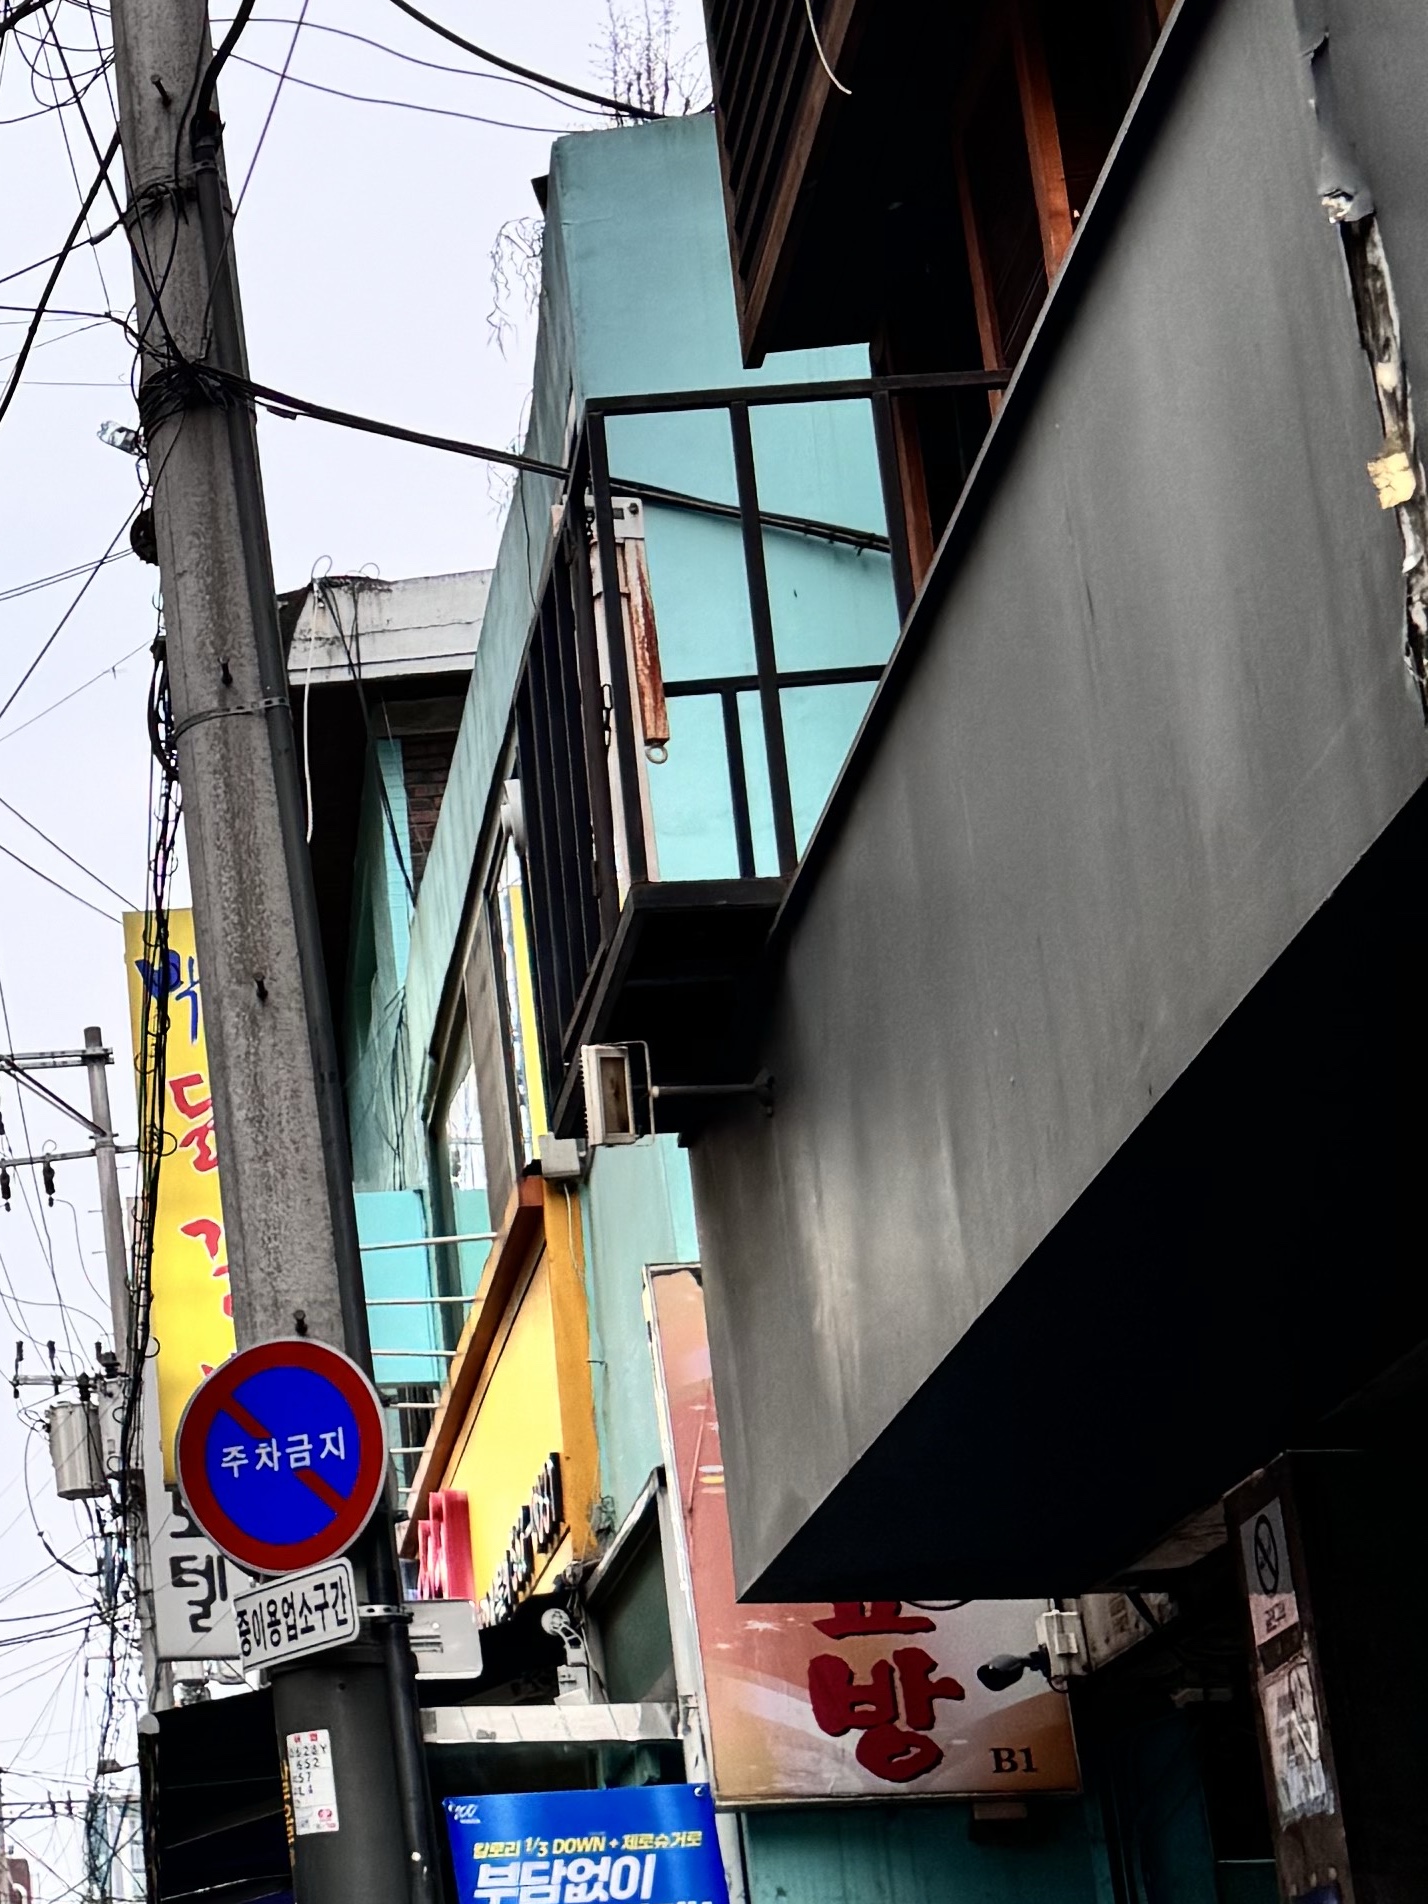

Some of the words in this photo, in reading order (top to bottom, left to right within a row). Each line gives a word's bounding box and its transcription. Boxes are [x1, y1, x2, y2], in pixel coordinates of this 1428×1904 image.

[221, 1424, 347, 1479] 주차금지
[991, 1747, 1039, 1774] B1
[552, 1836, 607, 1854] DOWN
[621, 1831, 703, 1851] 제로슈거로
